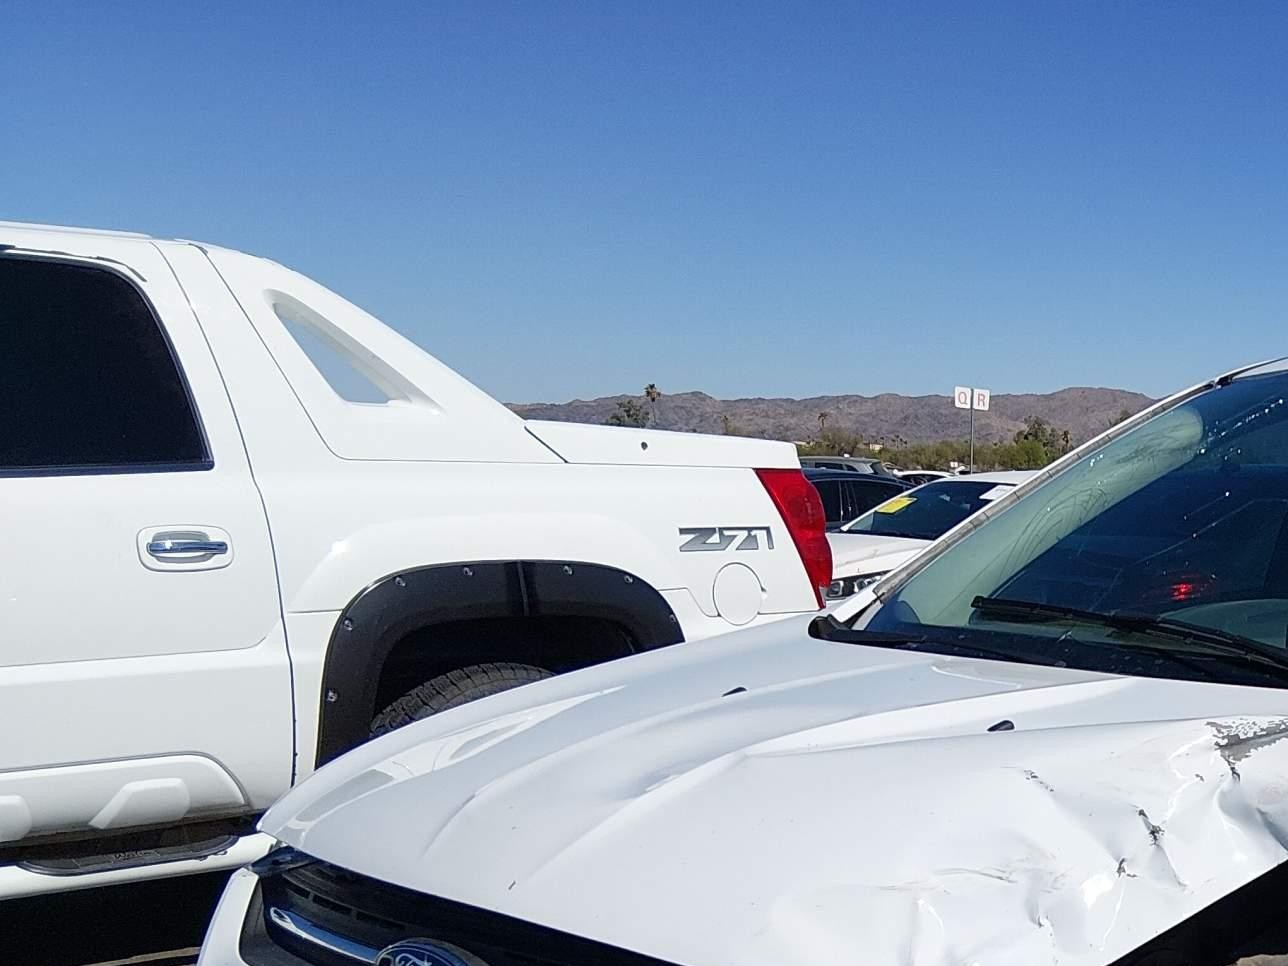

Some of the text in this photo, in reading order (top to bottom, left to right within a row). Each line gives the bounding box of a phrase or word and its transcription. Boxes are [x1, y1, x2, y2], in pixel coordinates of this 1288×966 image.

[958, 391, 968, 405] Q
[977, 393, 986, 406] R
[679, 526, 774, 551] Z71
